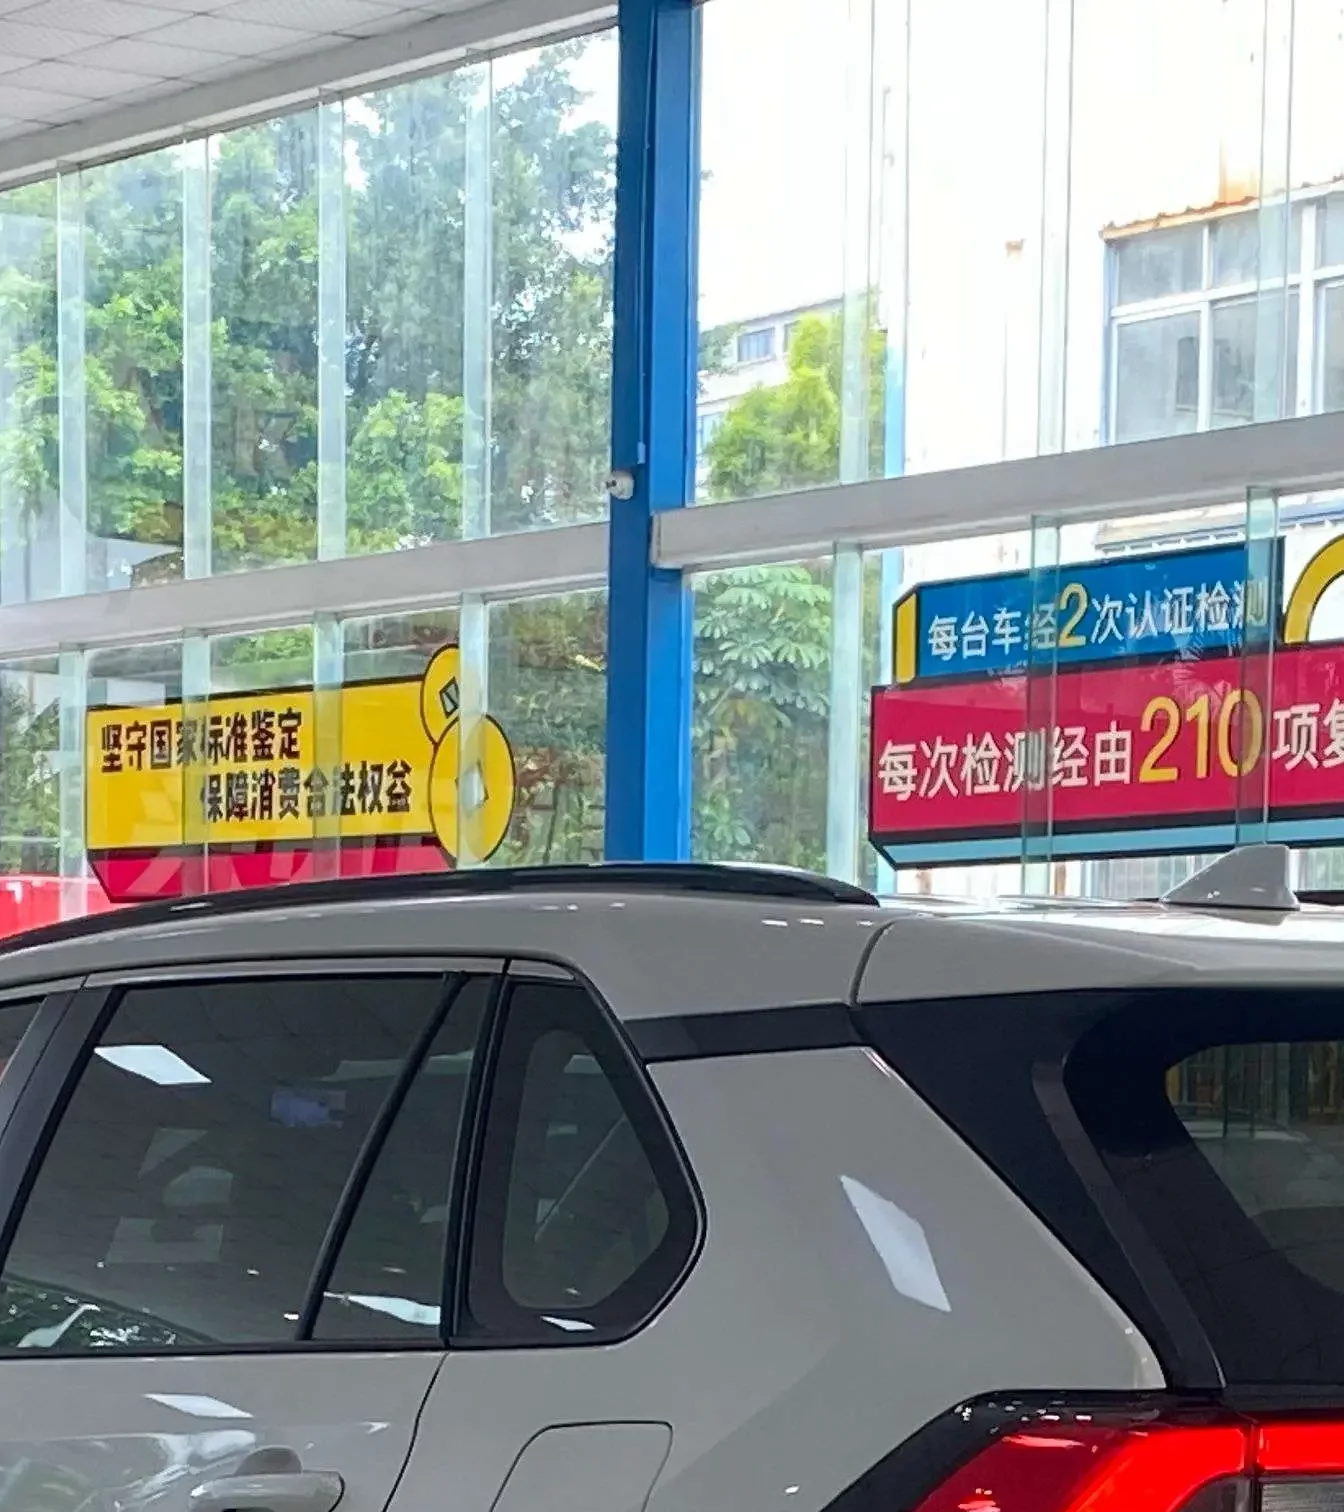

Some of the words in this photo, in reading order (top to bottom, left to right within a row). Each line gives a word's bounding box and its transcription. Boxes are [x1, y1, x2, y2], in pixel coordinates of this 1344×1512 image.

[926, 581, 1267, 661] 每台车经2次认证检测
[100, 706, 304, 774] 坚守国家标准鉴定
[200, 760, 413, 825] 保障消费合法权益
